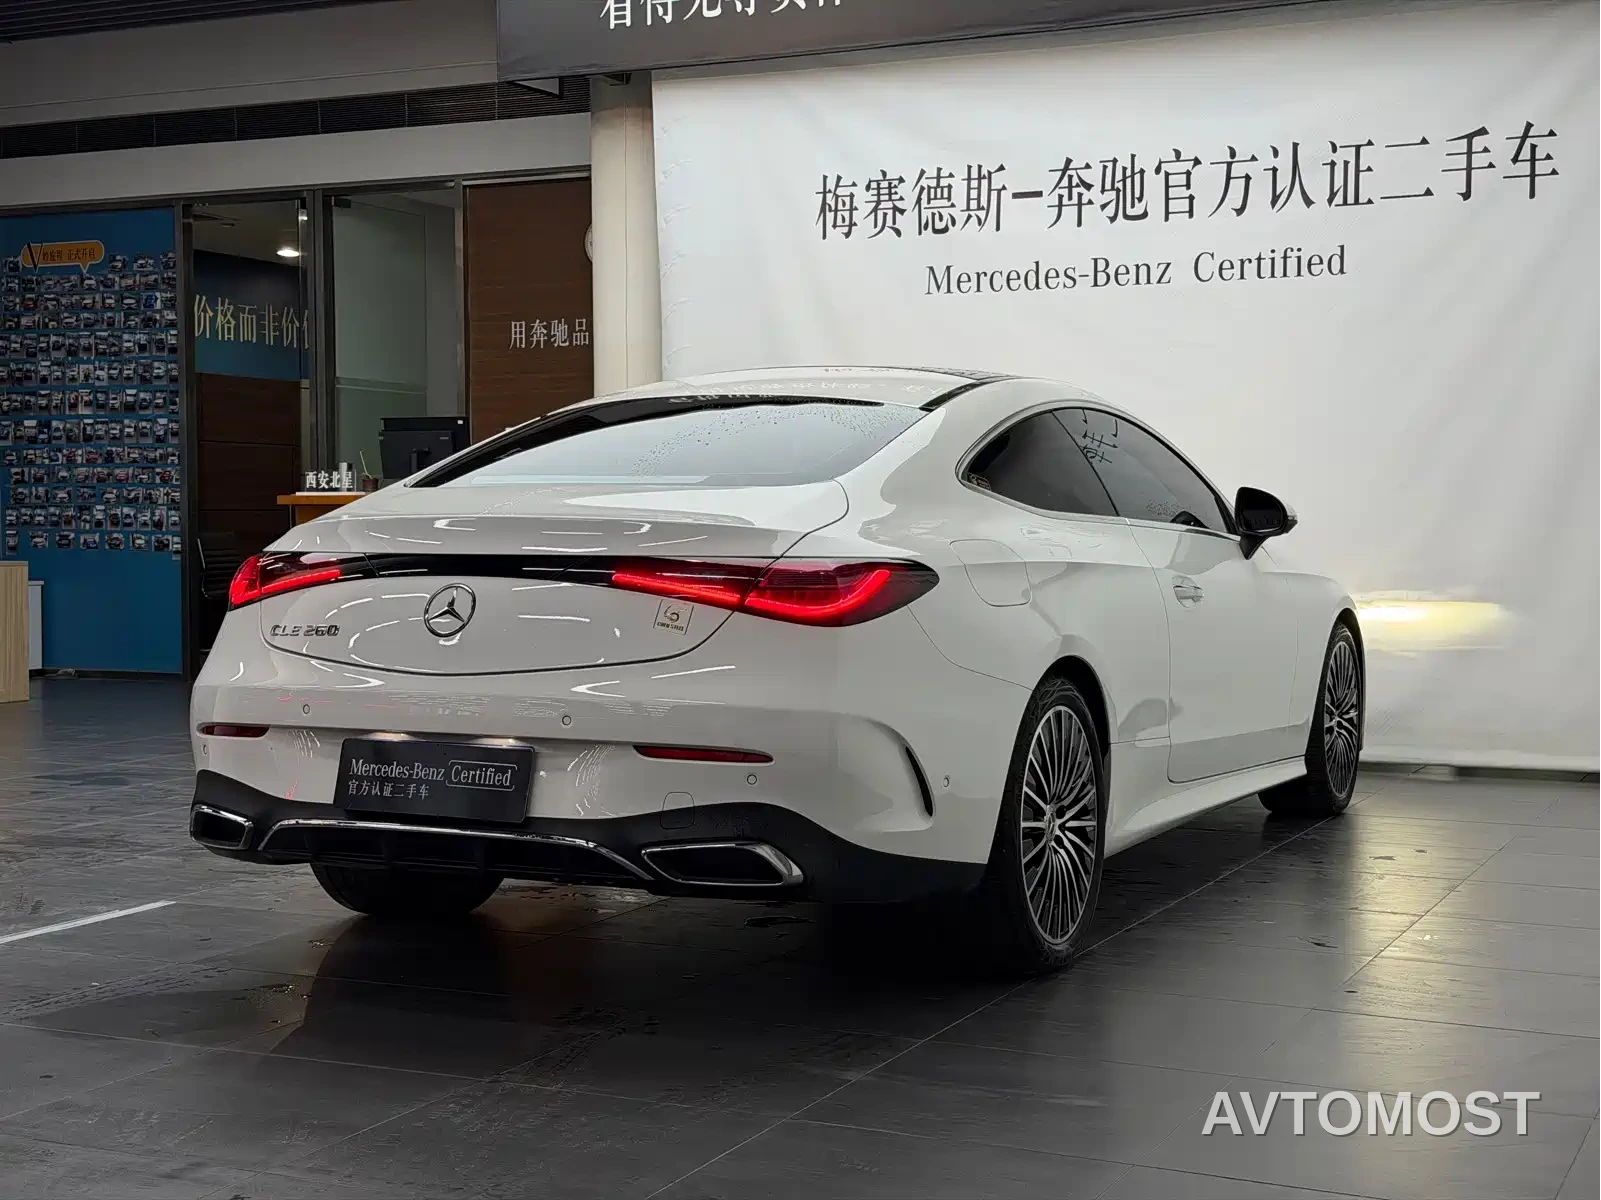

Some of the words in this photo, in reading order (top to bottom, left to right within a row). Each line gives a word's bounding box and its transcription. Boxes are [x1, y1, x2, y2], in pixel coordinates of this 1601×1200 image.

[815, 120, 1560, 241] 梅赛德斯-奔驰官方认证二手车
[925, 257, 1173, 296] Mercedes-Benz
[1193, 244, 1347, 283] Certified
[509, 318, 590, 349] 用奔驰品
[305, 470, 354, 489] 西安北星
[303, 624, 340, 637] 260
[349, 758, 446, 782] Mercedes-Benz
[451, 764, 513, 787] Certified
[348, 779, 430, 800] 官方认证二手车
